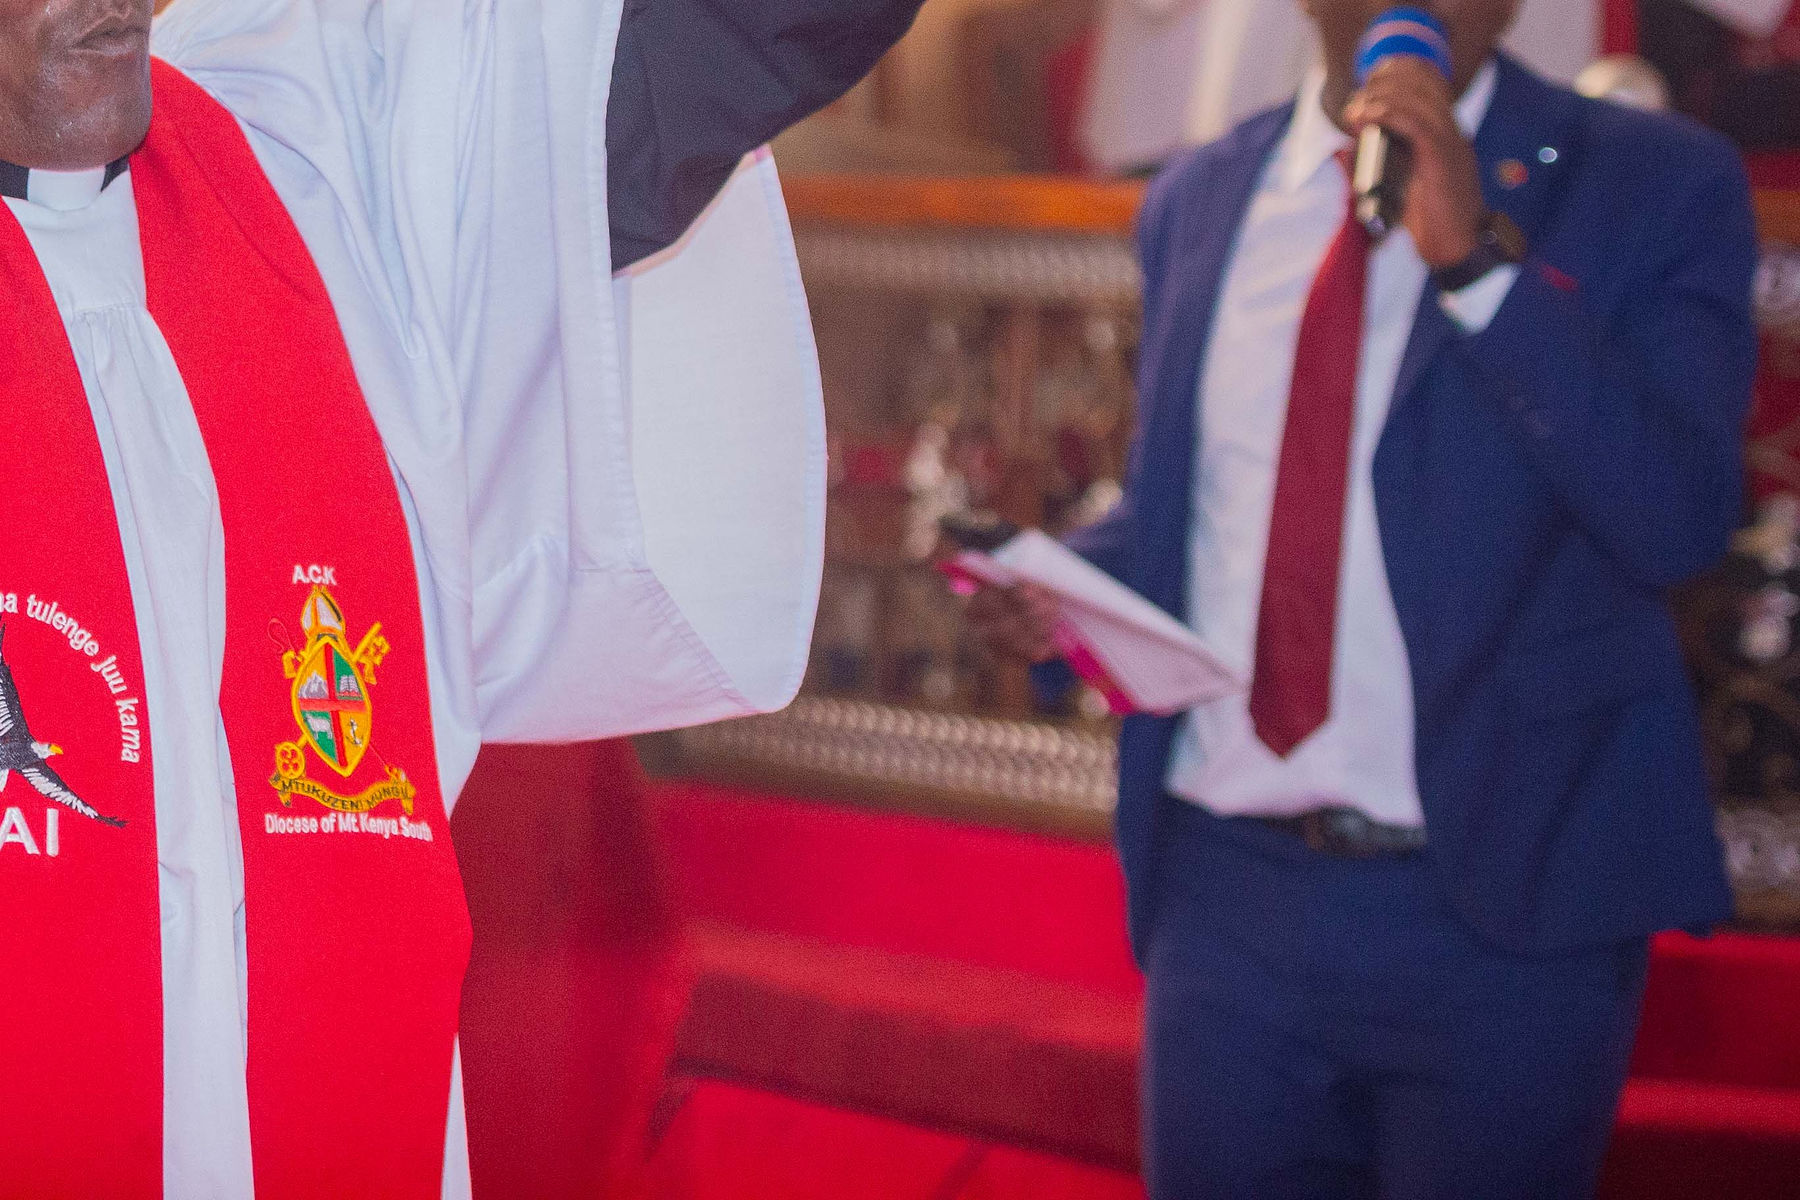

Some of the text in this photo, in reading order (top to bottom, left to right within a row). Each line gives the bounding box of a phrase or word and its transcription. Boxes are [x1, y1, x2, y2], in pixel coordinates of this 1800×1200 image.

[26, 594, 100, 657] tulenge
[90, 655, 128, 695] juu
[115, 697, 141, 763] kama
[265, 813, 318, 834] Diocese
[321, 812, 337, 833] of
[359, 812, 398, 839] Kenya
[400, 816, 433, 842] South
